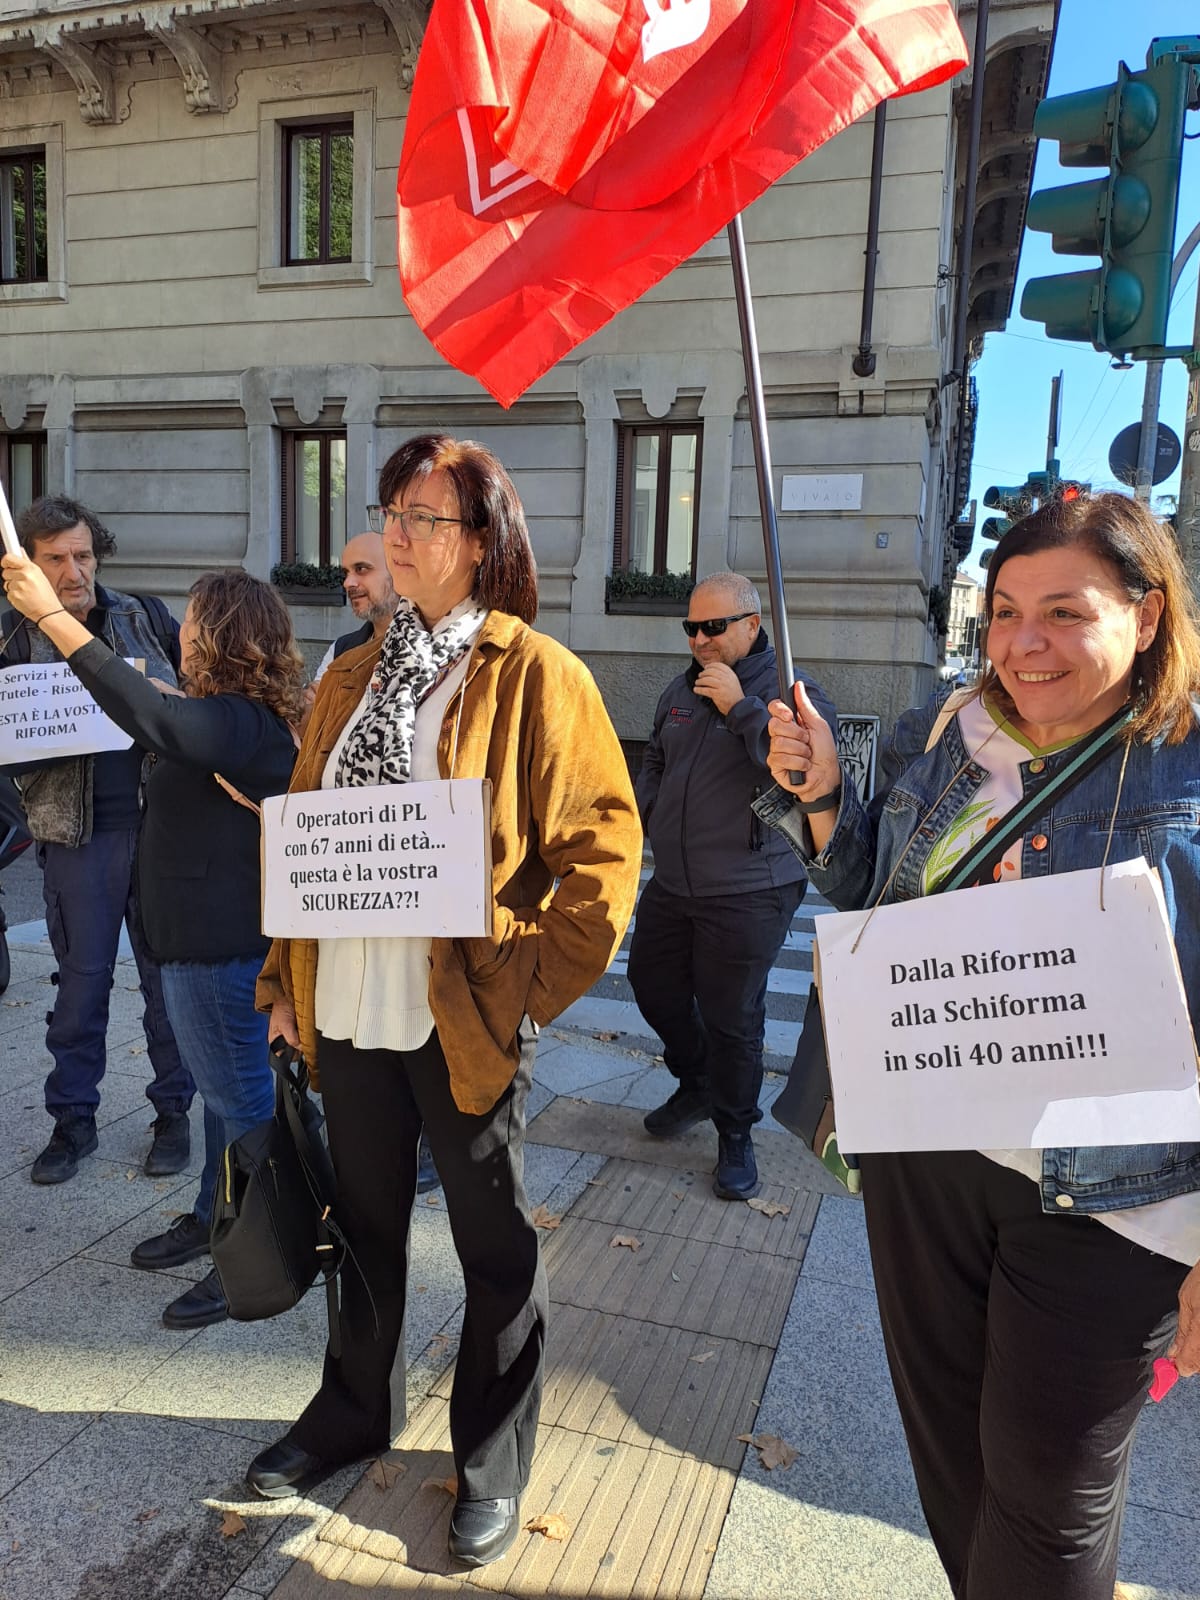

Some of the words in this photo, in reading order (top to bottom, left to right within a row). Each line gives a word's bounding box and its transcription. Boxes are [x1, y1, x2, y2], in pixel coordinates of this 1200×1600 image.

[4, 670, 48, 684] Servizi
[0, 687, 39, 701] Tutele
[32, 708, 40, 720] È
[44, 709, 60, 720] LA
[15, 723, 77, 739] RIFORMA
[297, 806, 374, 832] Operatori
[379, 804, 396, 823] di
[402, 803, 427, 821] PL
[285, 842, 307, 857] con
[311, 837, 329, 855] 67
[335, 835, 372, 854] anni
[378, 833, 395, 852] di
[401, 830, 446, 850] età...
[290, 867, 337, 888] questa
[343, 864, 351, 881] è
[357, 864, 372, 881] la
[378, 863, 438, 880] vostra
[302, 890, 420, 912] SICUREZZA??!
[890, 958, 955, 985] Dalla
[961, 947, 1077, 976] Riforma
[891, 1003, 937, 1027] alla
[944, 992, 1087, 1023] Schiforma
[884, 1050, 908, 1072] in
[915, 1045, 962, 1070] soli
[969, 1042, 1003, 1066] 40
[1011, 1033, 1108, 1063] anni!!!
